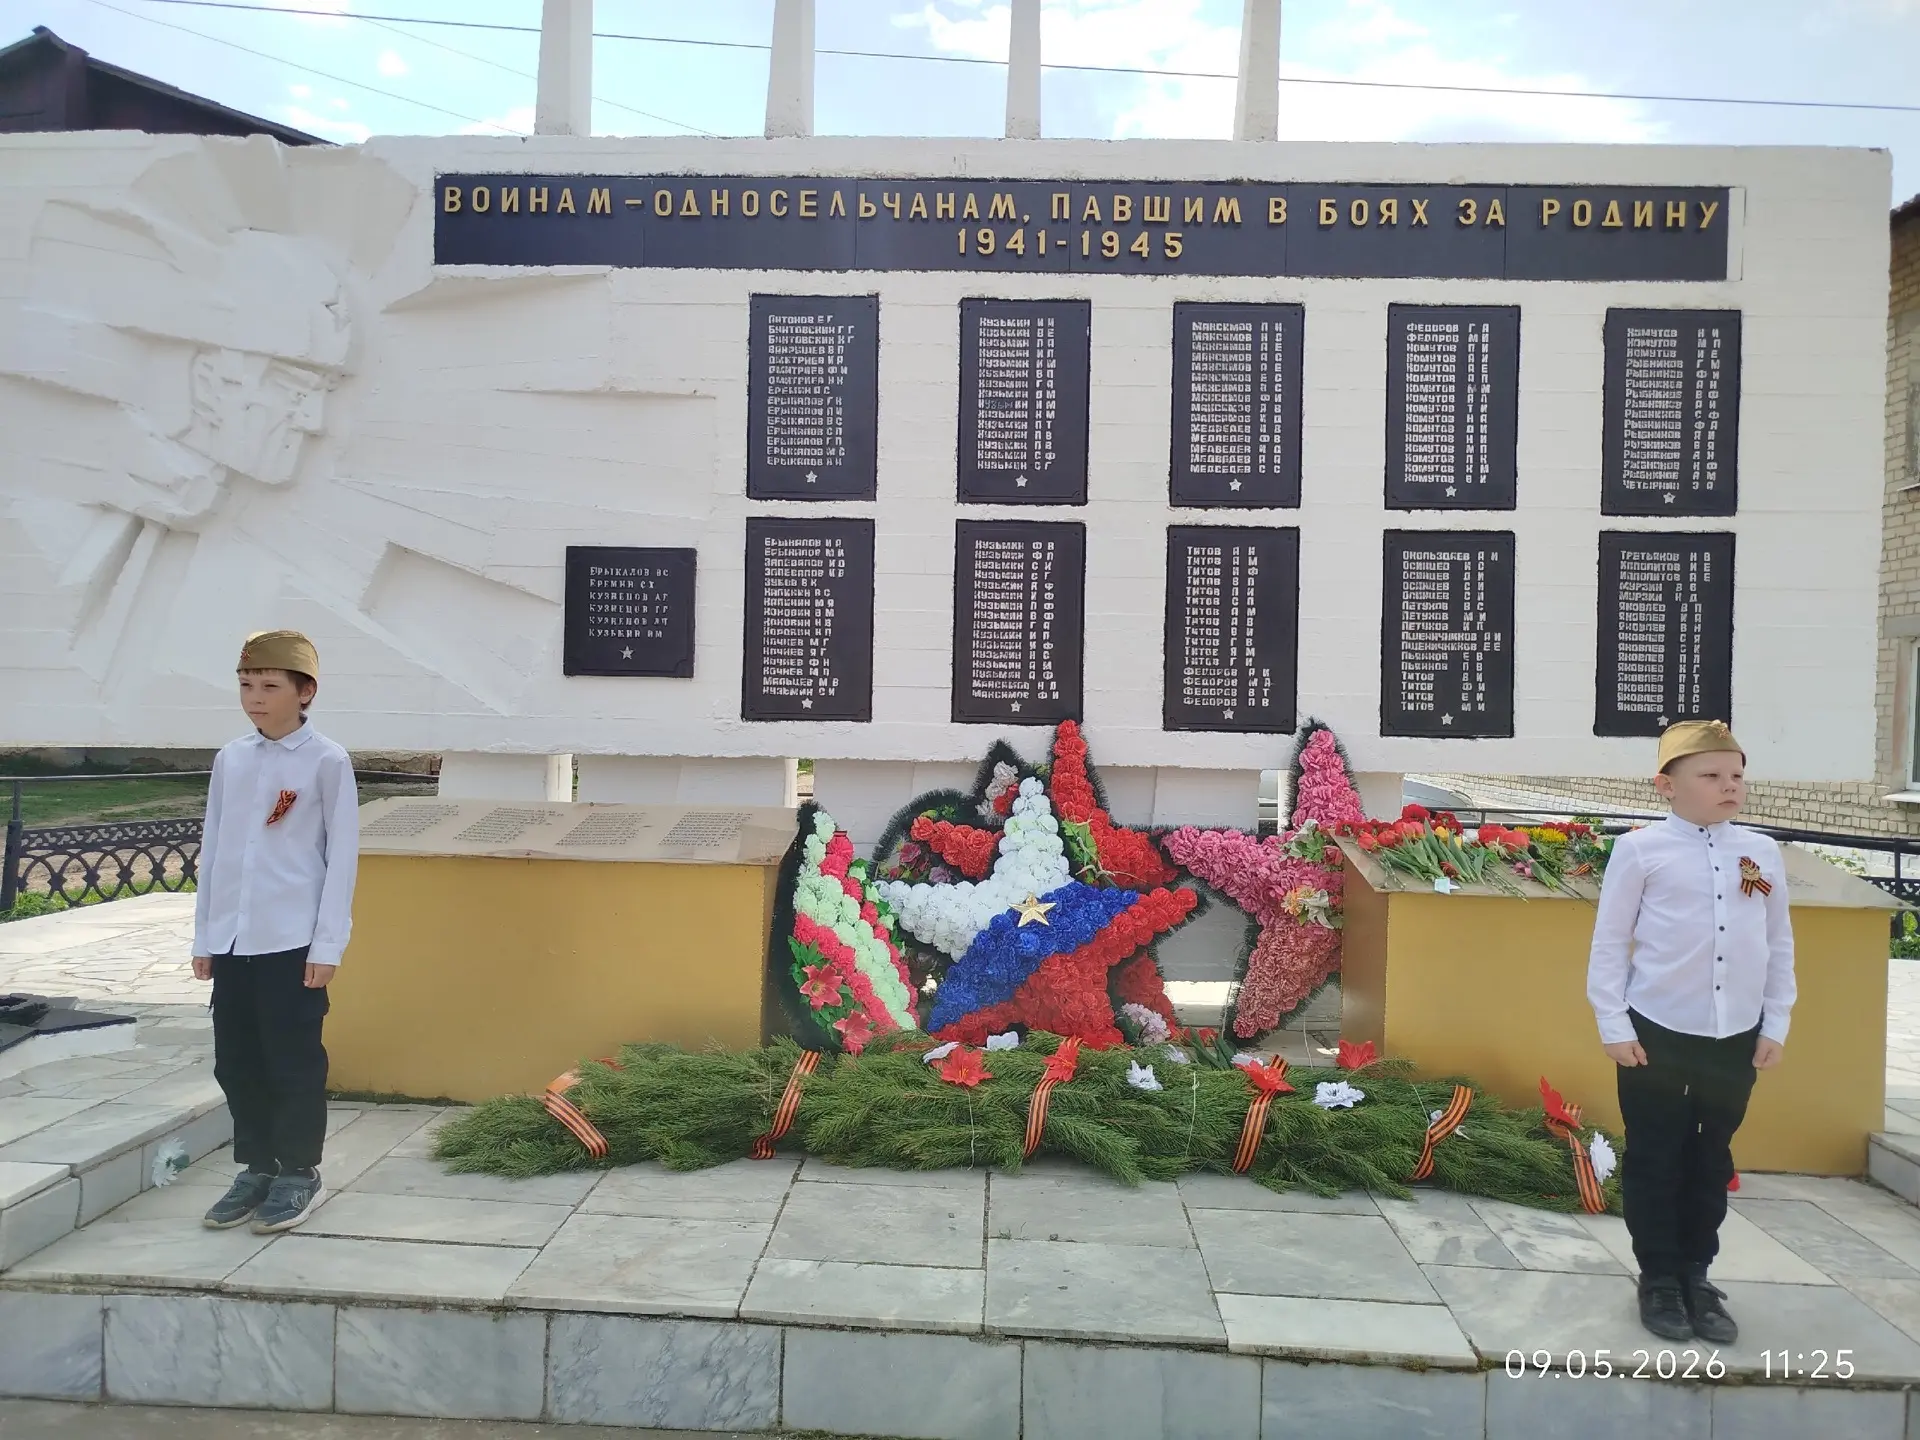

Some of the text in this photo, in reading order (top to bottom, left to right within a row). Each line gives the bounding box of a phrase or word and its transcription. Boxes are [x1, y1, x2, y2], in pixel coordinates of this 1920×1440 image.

[1052, 193, 1242, 223] ПАВШИМ
[1269, 197, 1288, 224] В
[1319, 198, 1430, 227] БОЯХ
[1458, 199, 1506, 227] ЗА
[1543, 200, 1719, 229] РОДИНУ
[957, 228, 1184, 259] 1941-1945
